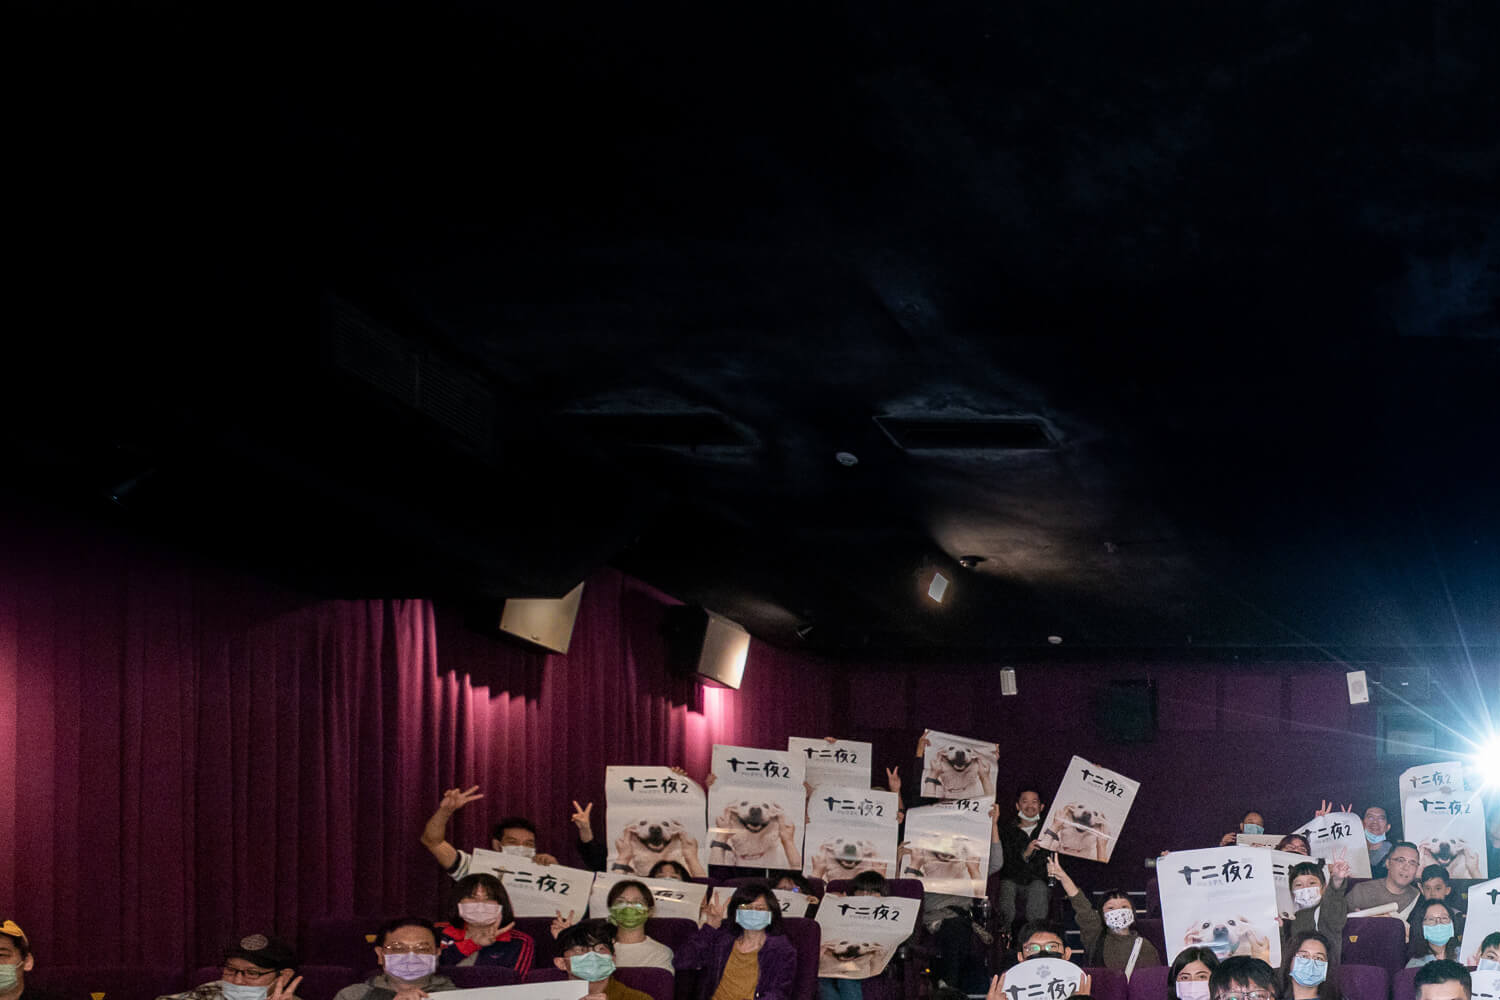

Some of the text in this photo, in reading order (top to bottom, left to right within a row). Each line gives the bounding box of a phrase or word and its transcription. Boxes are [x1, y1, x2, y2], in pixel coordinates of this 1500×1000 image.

[803, 747, 858, 764] 十二夜2
[726, 757, 791, 779] 十二夜2
[624, 776, 689, 794] 十二夜2
[1081, 768, 1125, 798] 十二夜2
[823, 796, 884, 817] 十二夜2
[1177, 858, 1254, 885] 十二夜2
[837, 903, 900, 922] 十二夜2
